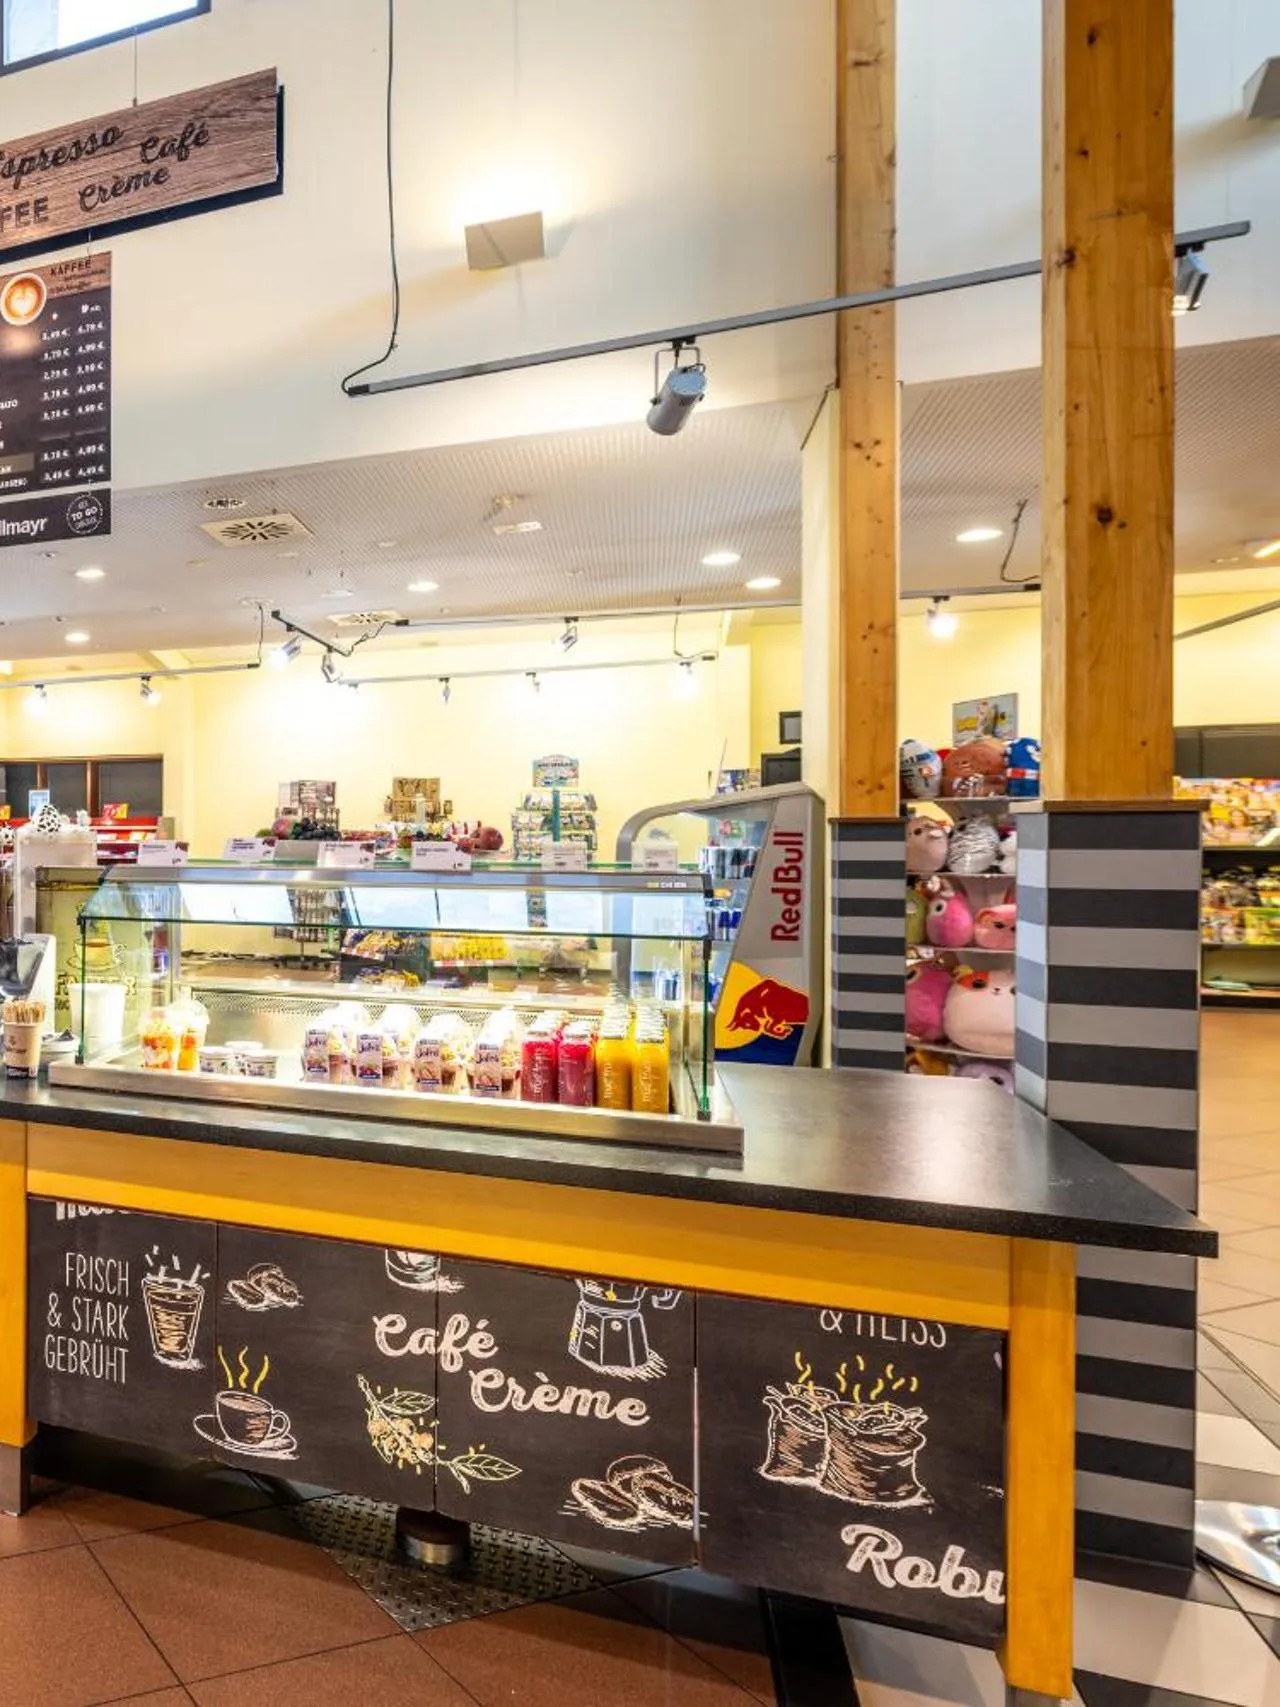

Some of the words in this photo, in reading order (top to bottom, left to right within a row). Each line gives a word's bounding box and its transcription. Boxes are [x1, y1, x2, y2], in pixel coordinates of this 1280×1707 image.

[138, 122, 210, 164] Café
[78, 163, 171, 213] Crème
[50, 258, 92, 277] KAFFEE
[70, 511, 83, 522] TO
[85, 506, 98, 517] GO
[773, 831, 804, 882] Bull
[771, 888, 801, 941] Red
[64, 1252, 130, 1297] FRISCH
[46, 1292, 63, 1331] &
[71, 1296, 130, 1342] STARK
[44, 1334, 130, 1386] GEBRÜHT
[372, 1312, 500, 1374] Café
[469, 1367, 652, 1428] Crème
